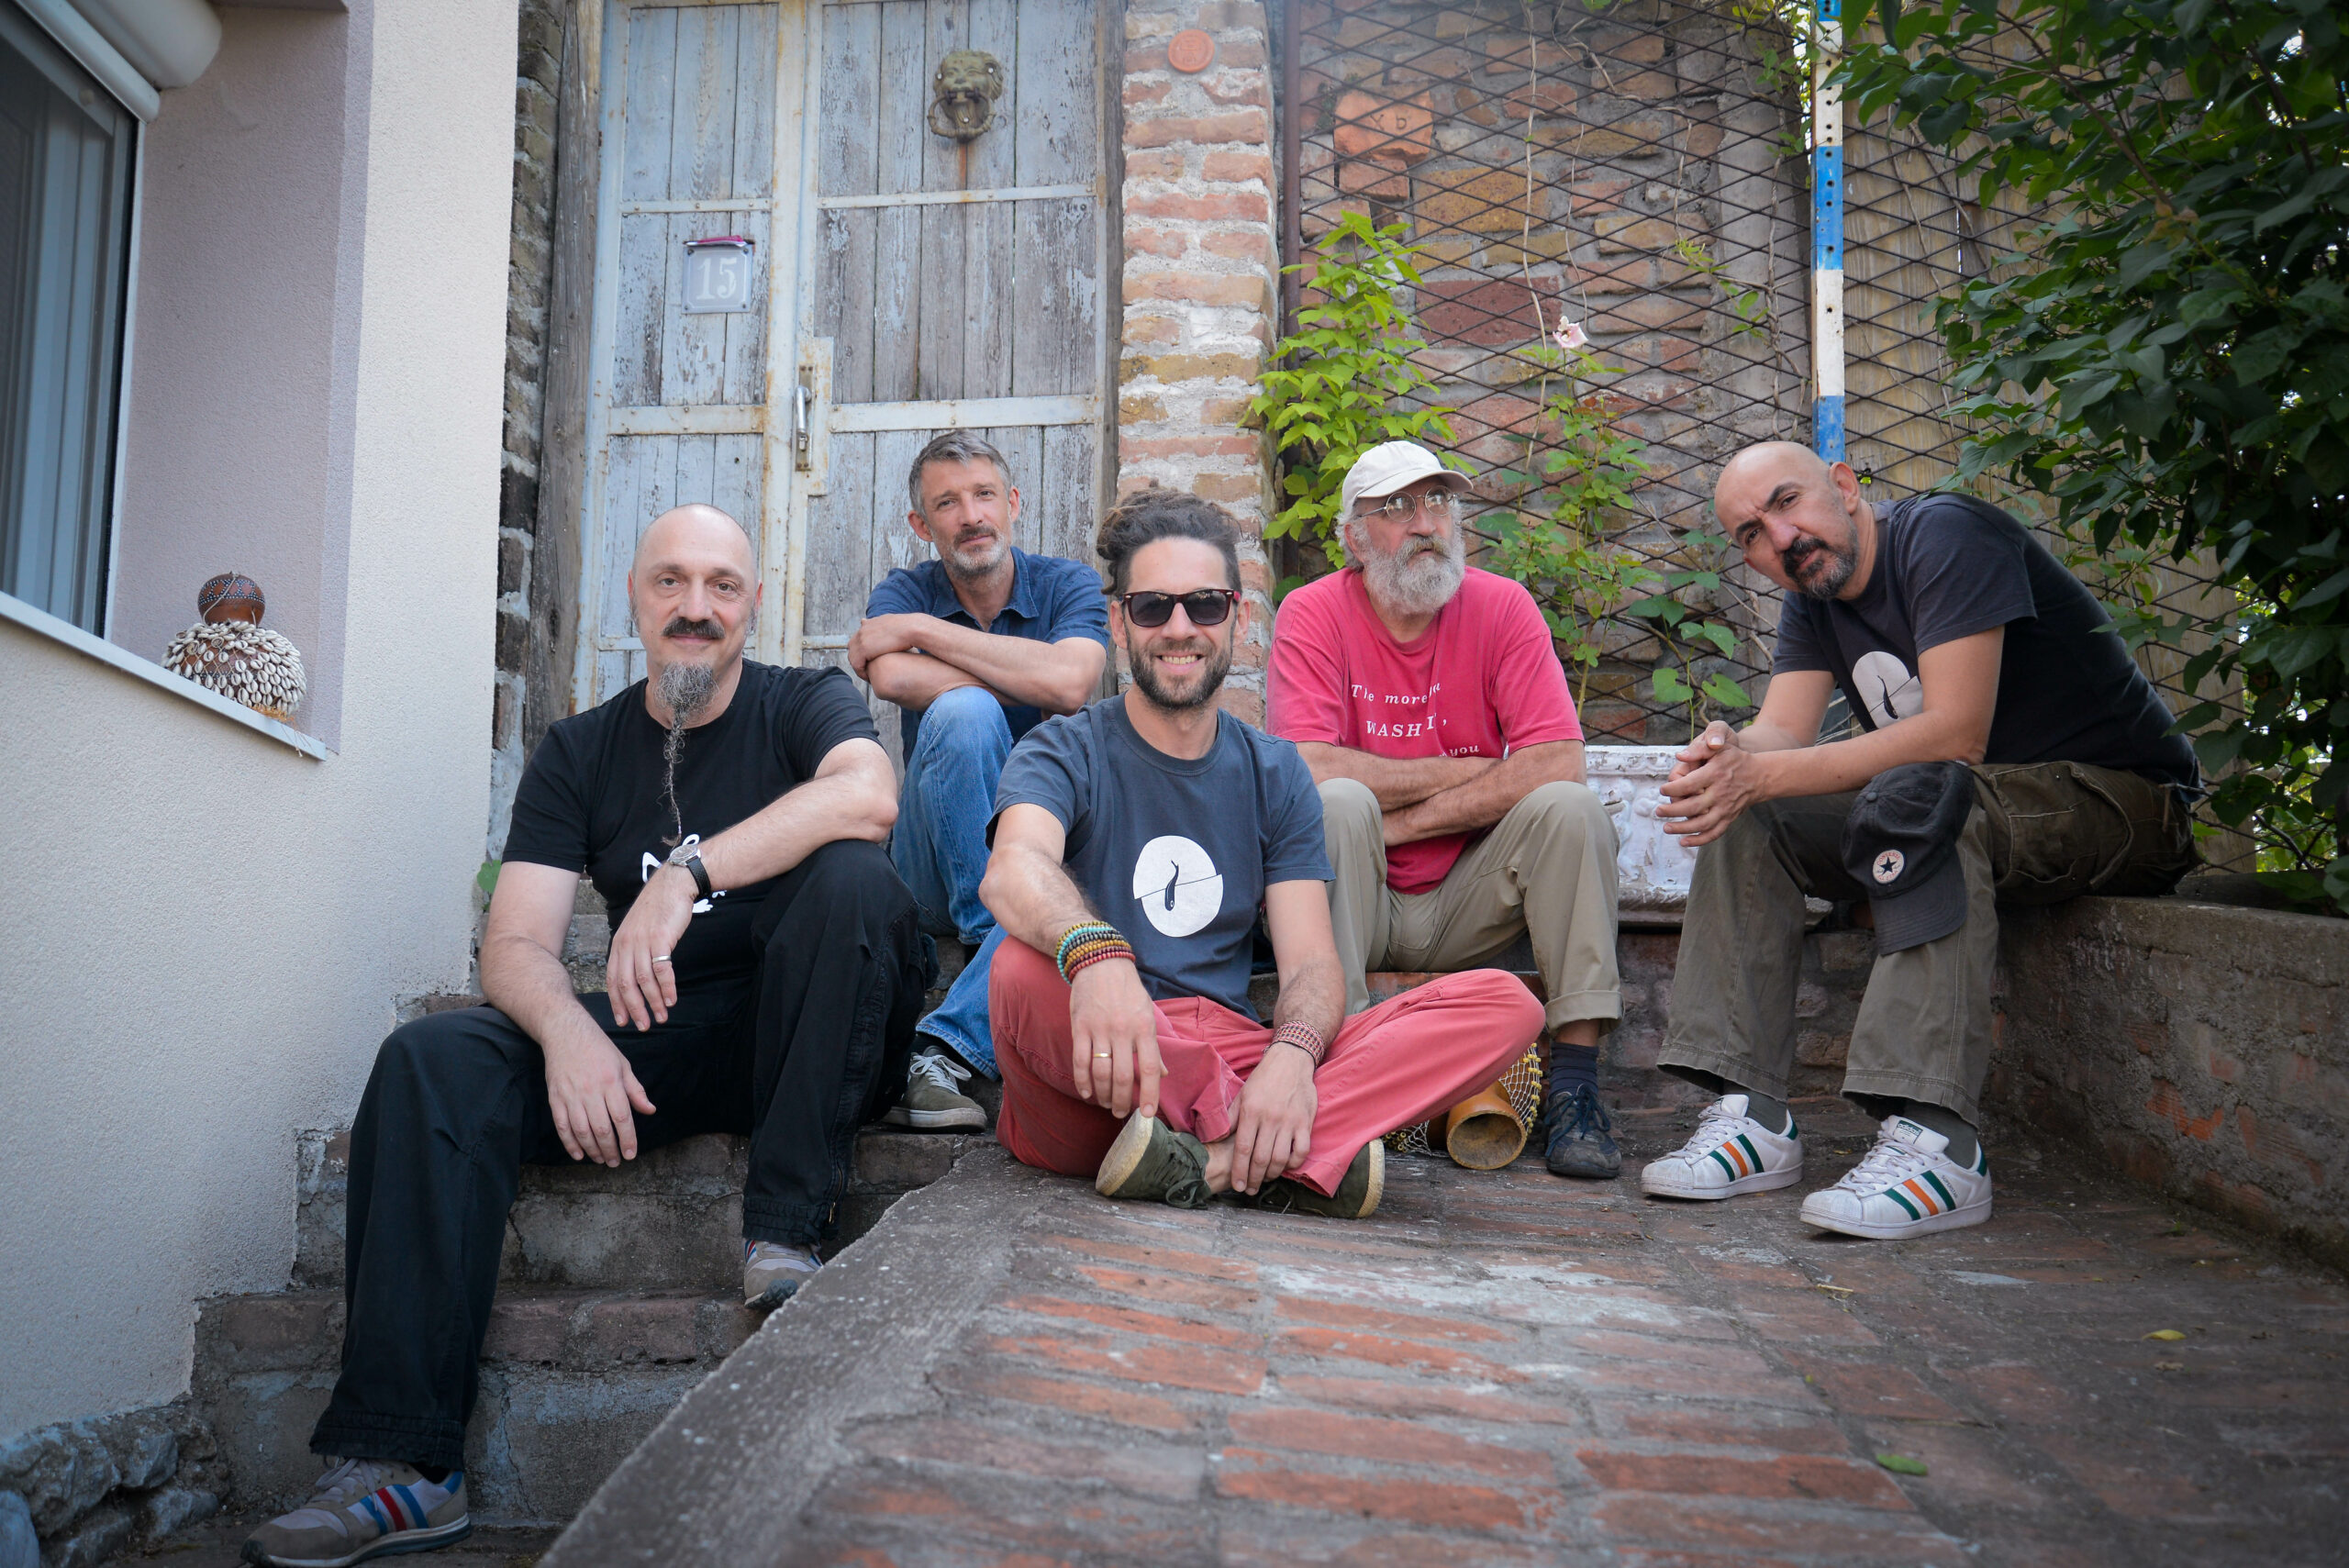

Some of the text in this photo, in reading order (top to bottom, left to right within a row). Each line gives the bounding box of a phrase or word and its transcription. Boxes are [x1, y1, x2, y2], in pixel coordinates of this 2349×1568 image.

[696, 257, 738, 301] 15
[1385, 694, 1428, 705] more
[1449, 744, 1480, 757] you
[1897, 1123, 1922, 1137] adidas
